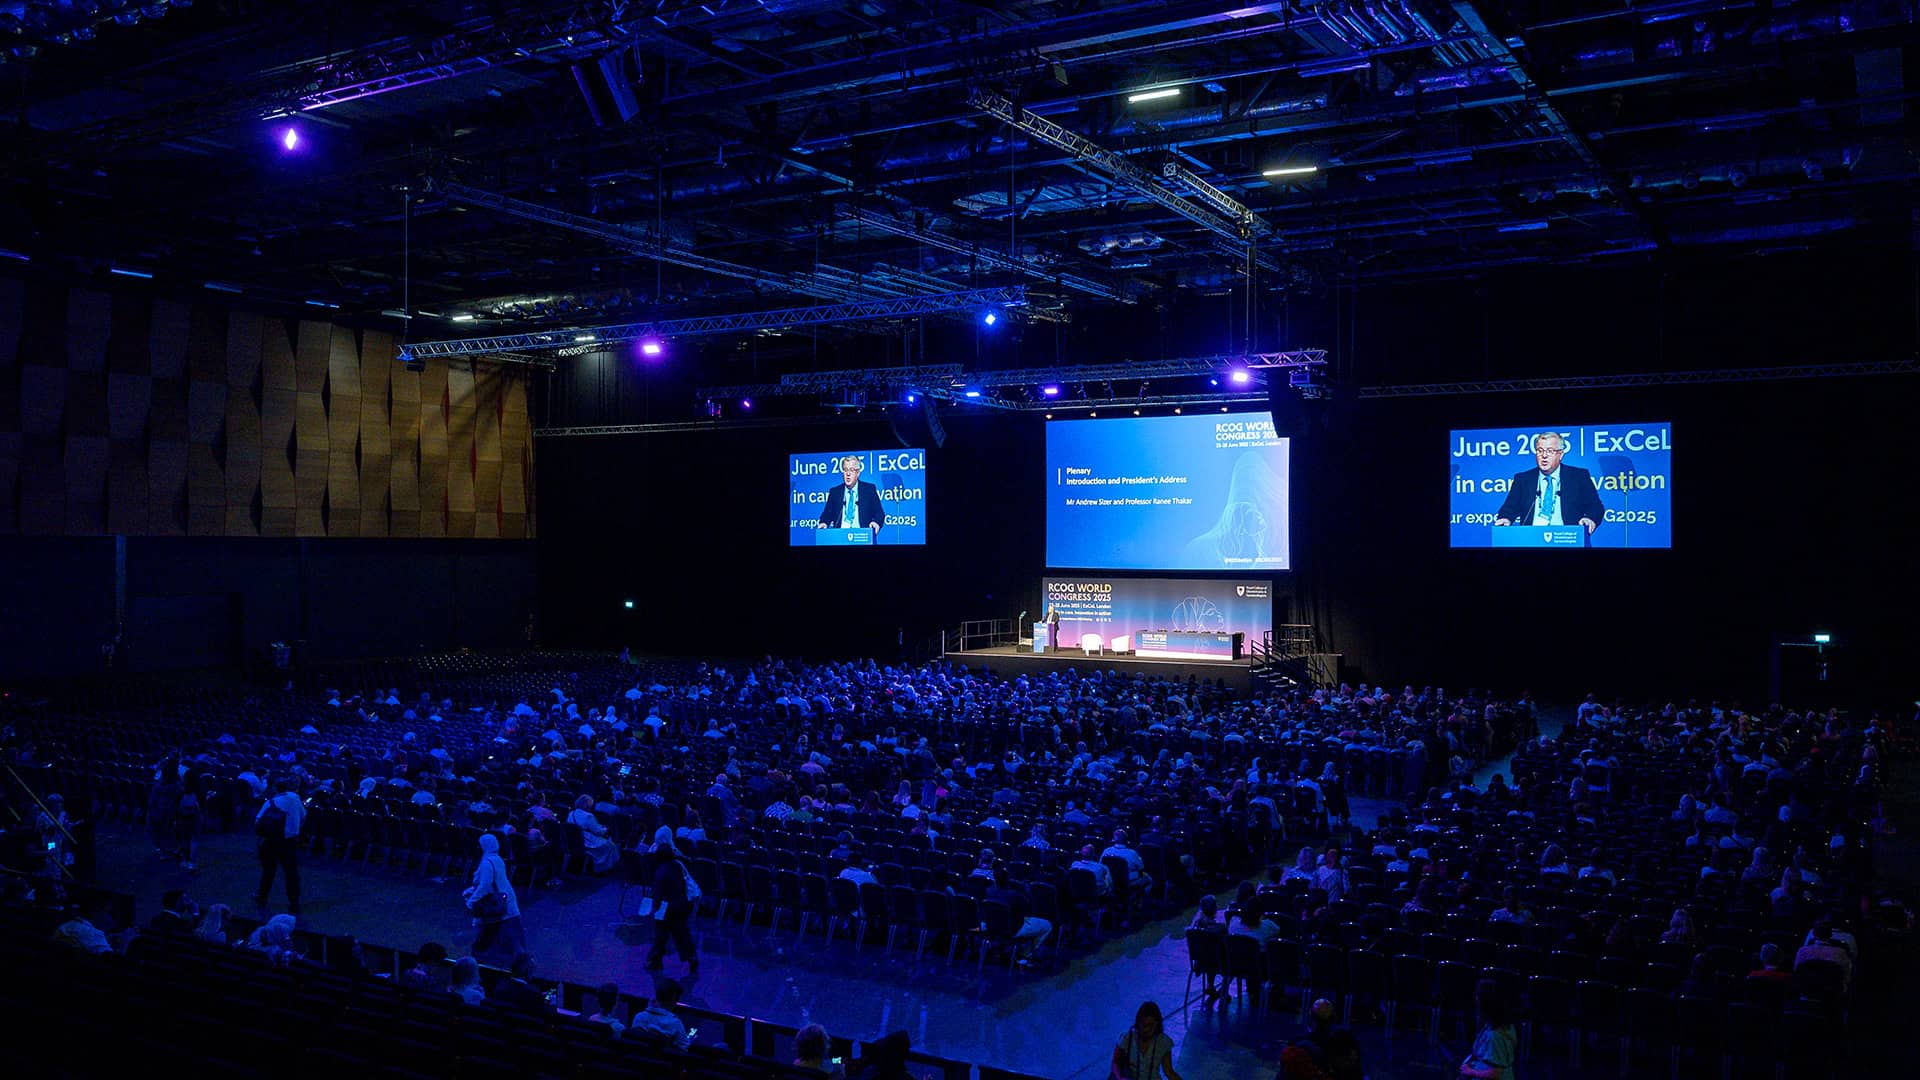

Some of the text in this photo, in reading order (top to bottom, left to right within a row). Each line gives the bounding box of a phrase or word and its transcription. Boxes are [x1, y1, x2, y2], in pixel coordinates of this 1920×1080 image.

[1216, 421, 1275, 433] RCOG WORL
[1216, 431, 1261, 441] CONGRESS
[1453, 437, 1510, 457] June
[1517, 432, 1571, 455] 205
[1594, 428, 1671, 452] ExCeL
[792, 459, 827, 475] June
[831, 456, 865, 474] 205
[879, 452, 926, 471] ExCeL
[1066, 467, 1091, 475] Plenary
[1066, 475, 1187, 485] Introduction and President's Address
[1456, 471, 1665, 493] in car vation
[793, 485, 922, 504] in car vation
[1066, 498, 1075, 506] Mr
[1076, 498, 1098, 506] Andrew
[1048, 583, 1112, 593] RCOG WORLD
[1048, 593, 1111, 602] CONGRESS 2025
